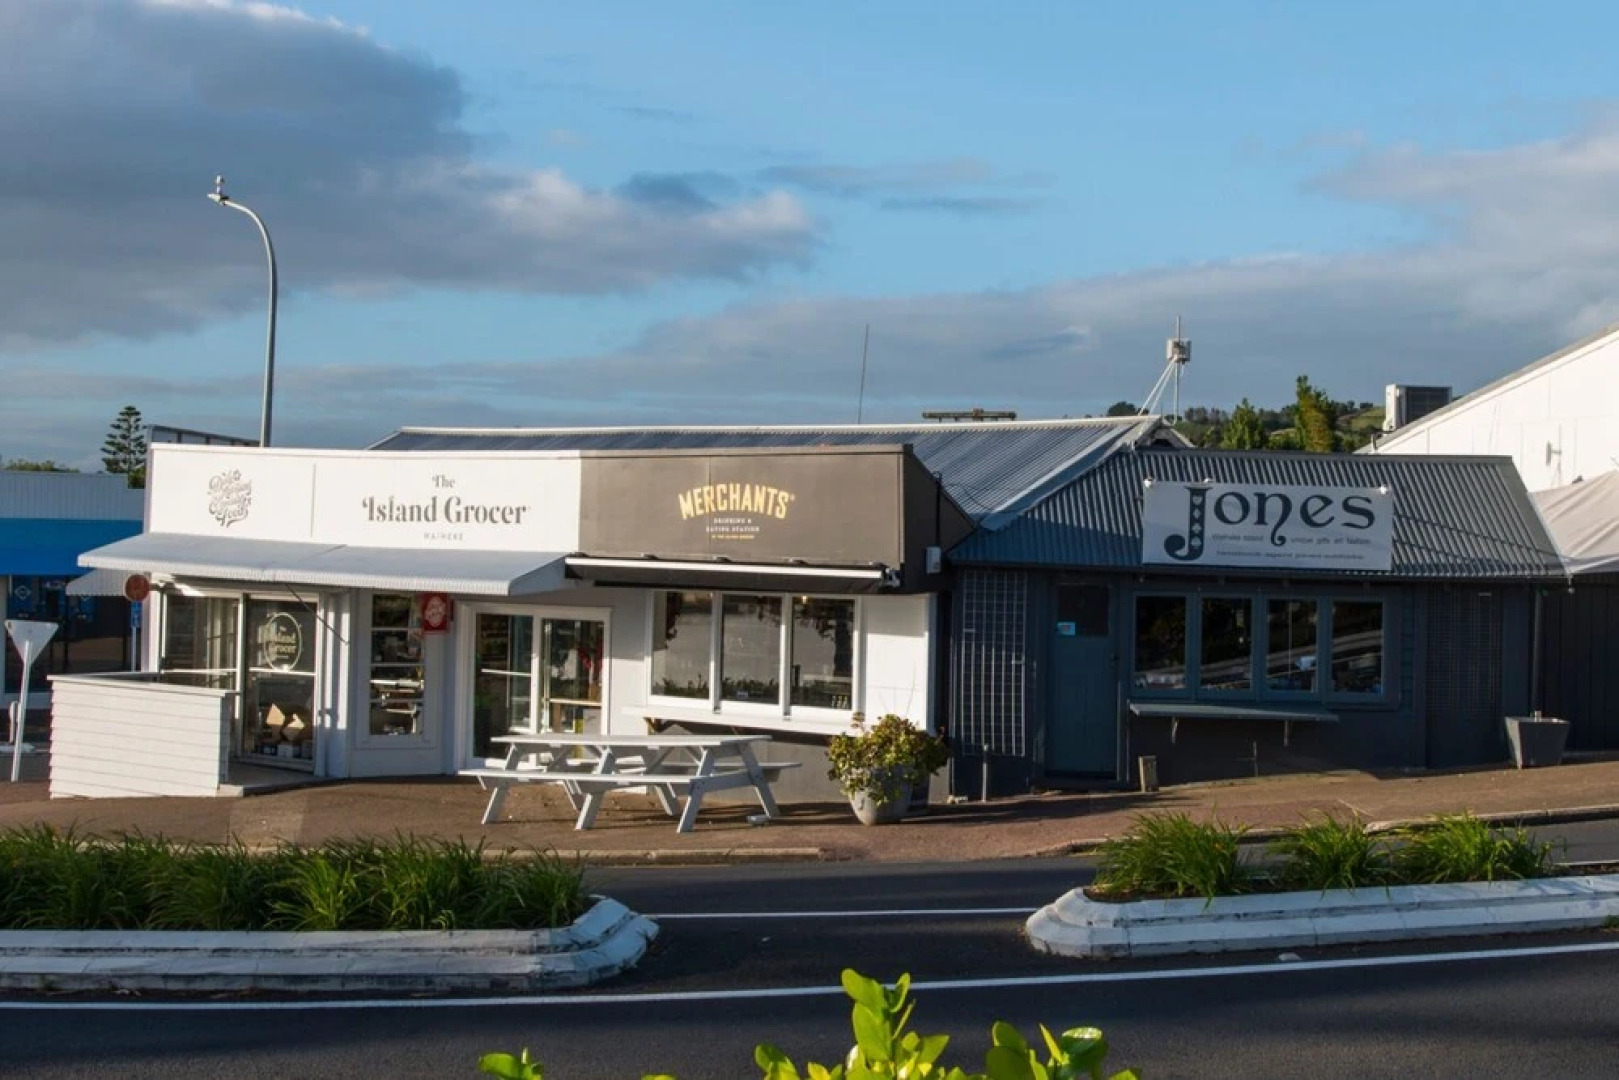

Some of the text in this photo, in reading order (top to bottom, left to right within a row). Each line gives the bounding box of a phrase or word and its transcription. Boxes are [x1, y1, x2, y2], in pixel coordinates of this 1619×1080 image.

[432, 474, 456, 488] The
[362, 495, 528, 524] Island Grocer
[1163, 486, 1376, 561] Jones
